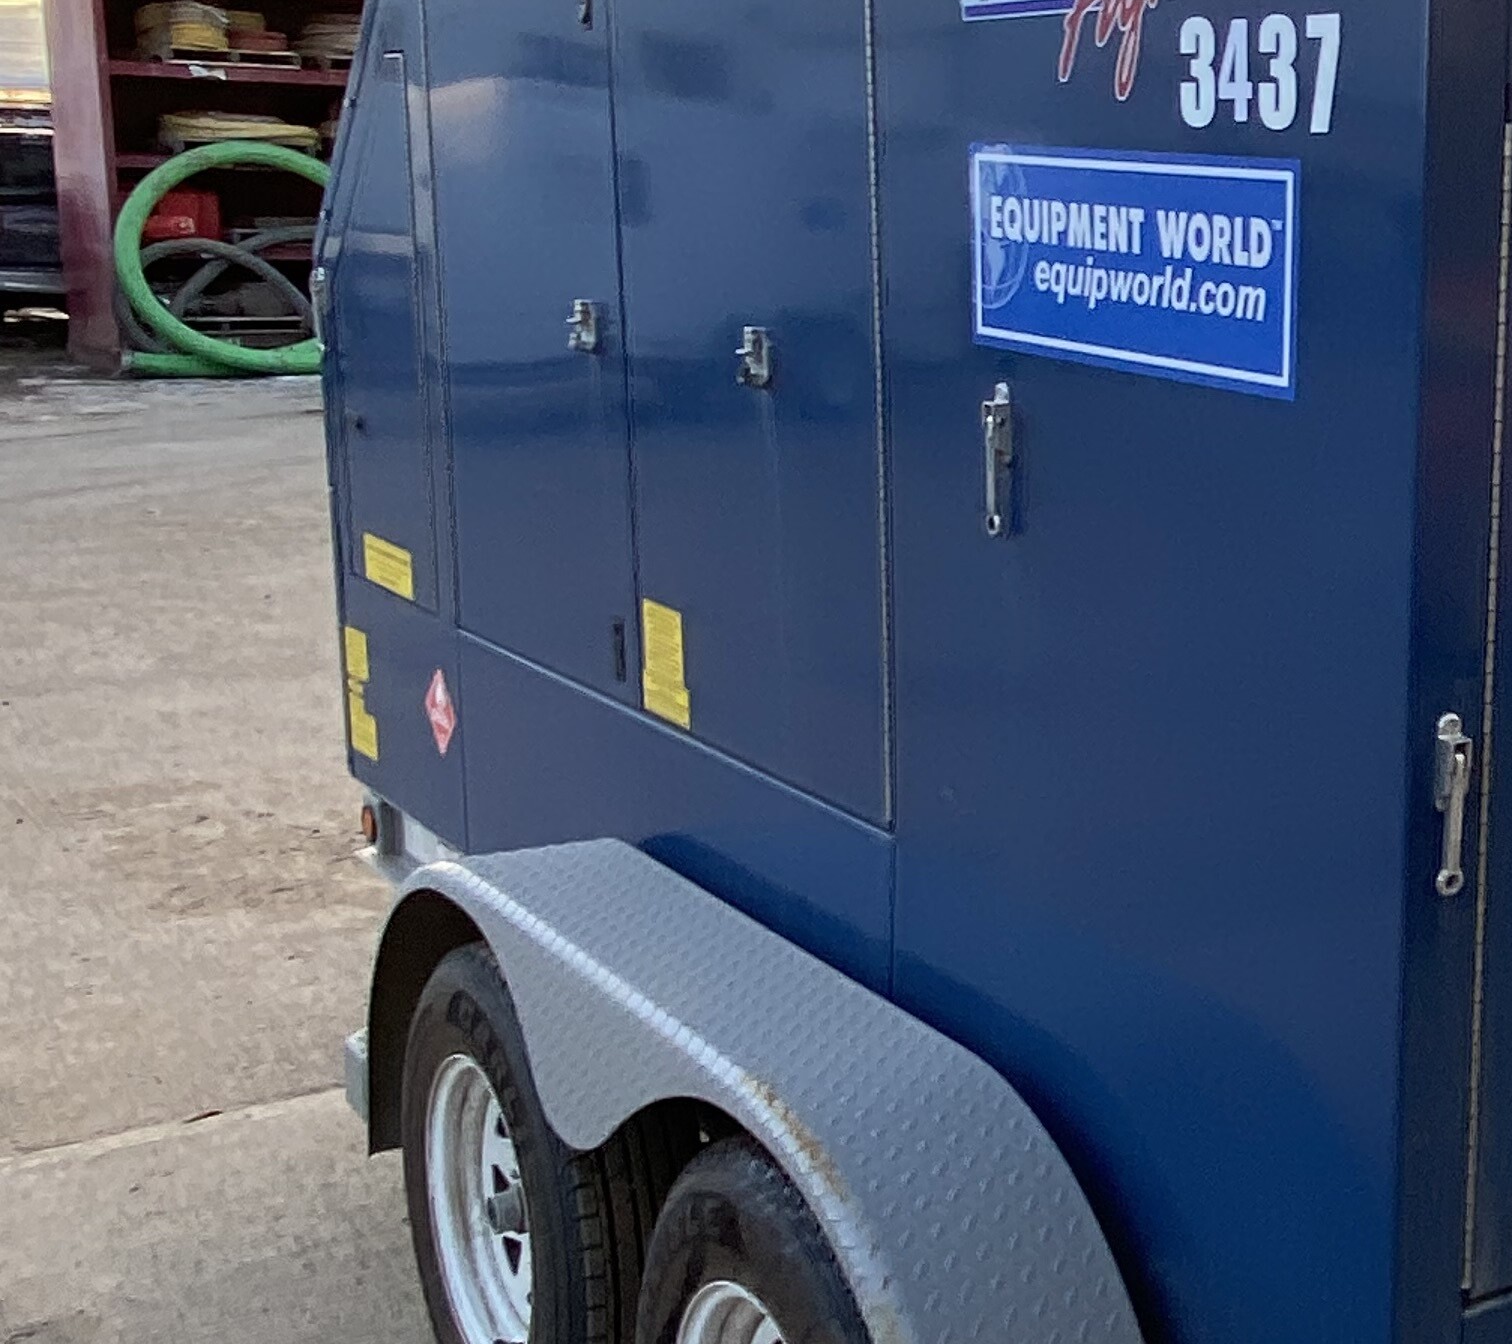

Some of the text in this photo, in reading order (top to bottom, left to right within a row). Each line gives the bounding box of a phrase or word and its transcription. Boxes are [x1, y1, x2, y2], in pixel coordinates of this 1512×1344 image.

[1179, 12, 1341, 134] 3437
[988, 196, 1145, 258] EQUIPMENT
[1034, 257, 1267, 322] equipworld.com
